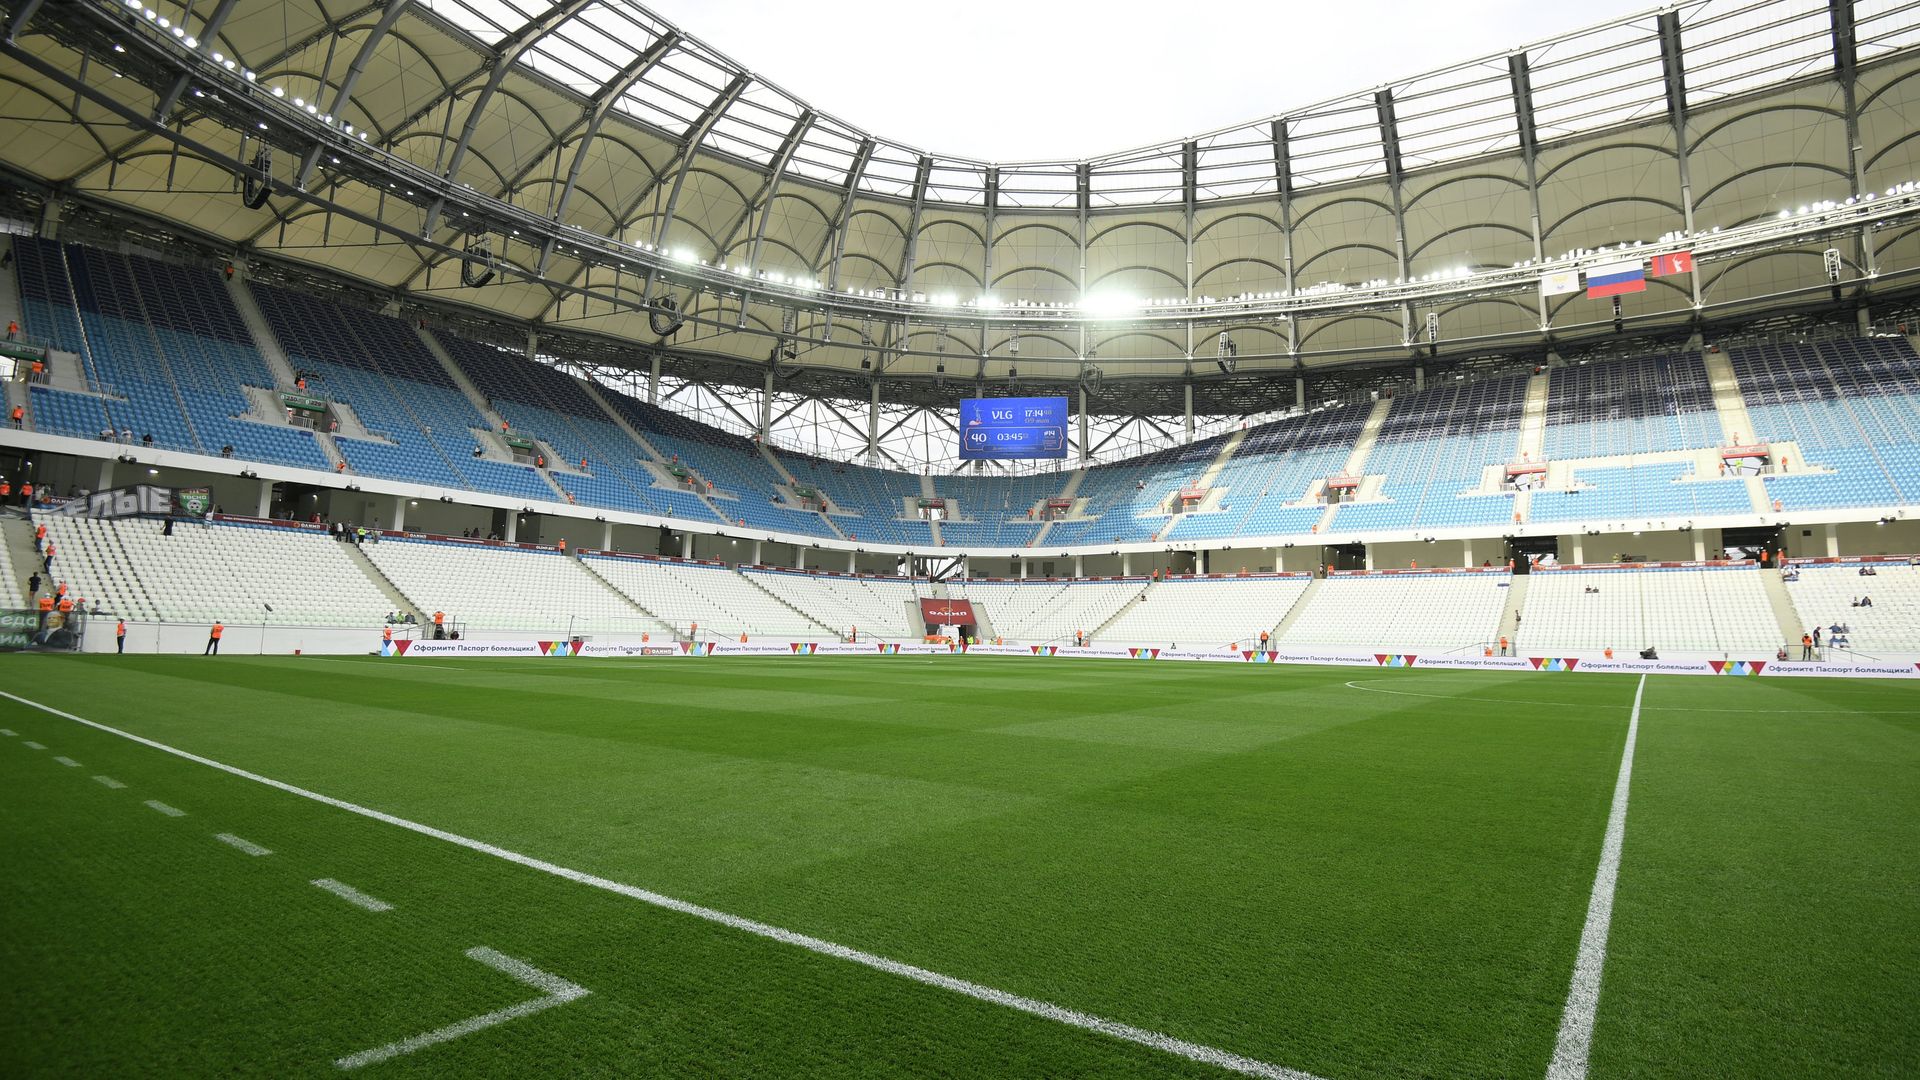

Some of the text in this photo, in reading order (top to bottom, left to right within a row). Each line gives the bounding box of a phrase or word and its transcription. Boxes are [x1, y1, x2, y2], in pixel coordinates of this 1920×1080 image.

[992, 410, 1013, 420] VLG
[1025, 410, 1043, 418] 17:14
[972, 432, 987, 442] 40
[997, 432, 1023, 441] 03:45
